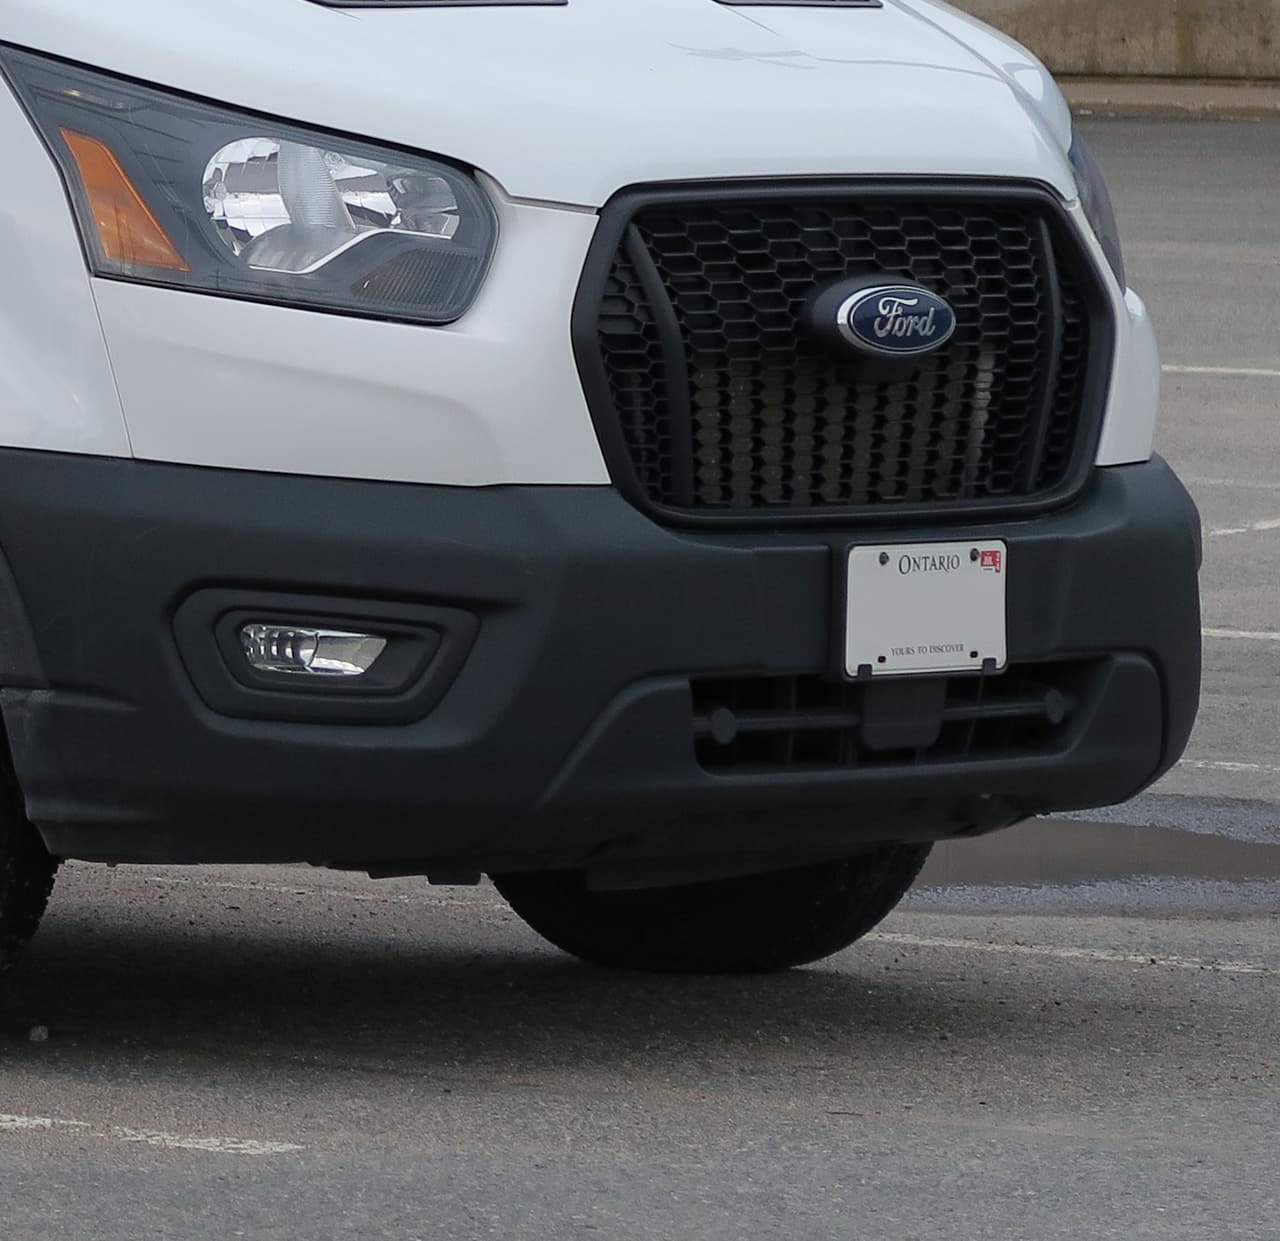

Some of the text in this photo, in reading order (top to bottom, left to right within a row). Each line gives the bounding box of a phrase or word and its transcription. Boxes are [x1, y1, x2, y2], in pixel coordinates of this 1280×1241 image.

[873, 296, 937, 338] Ford
[898, 554, 961, 575] ONTARIO
[890, 646, 916, 657] YOURS
[917, 645, 929, 655] TO
